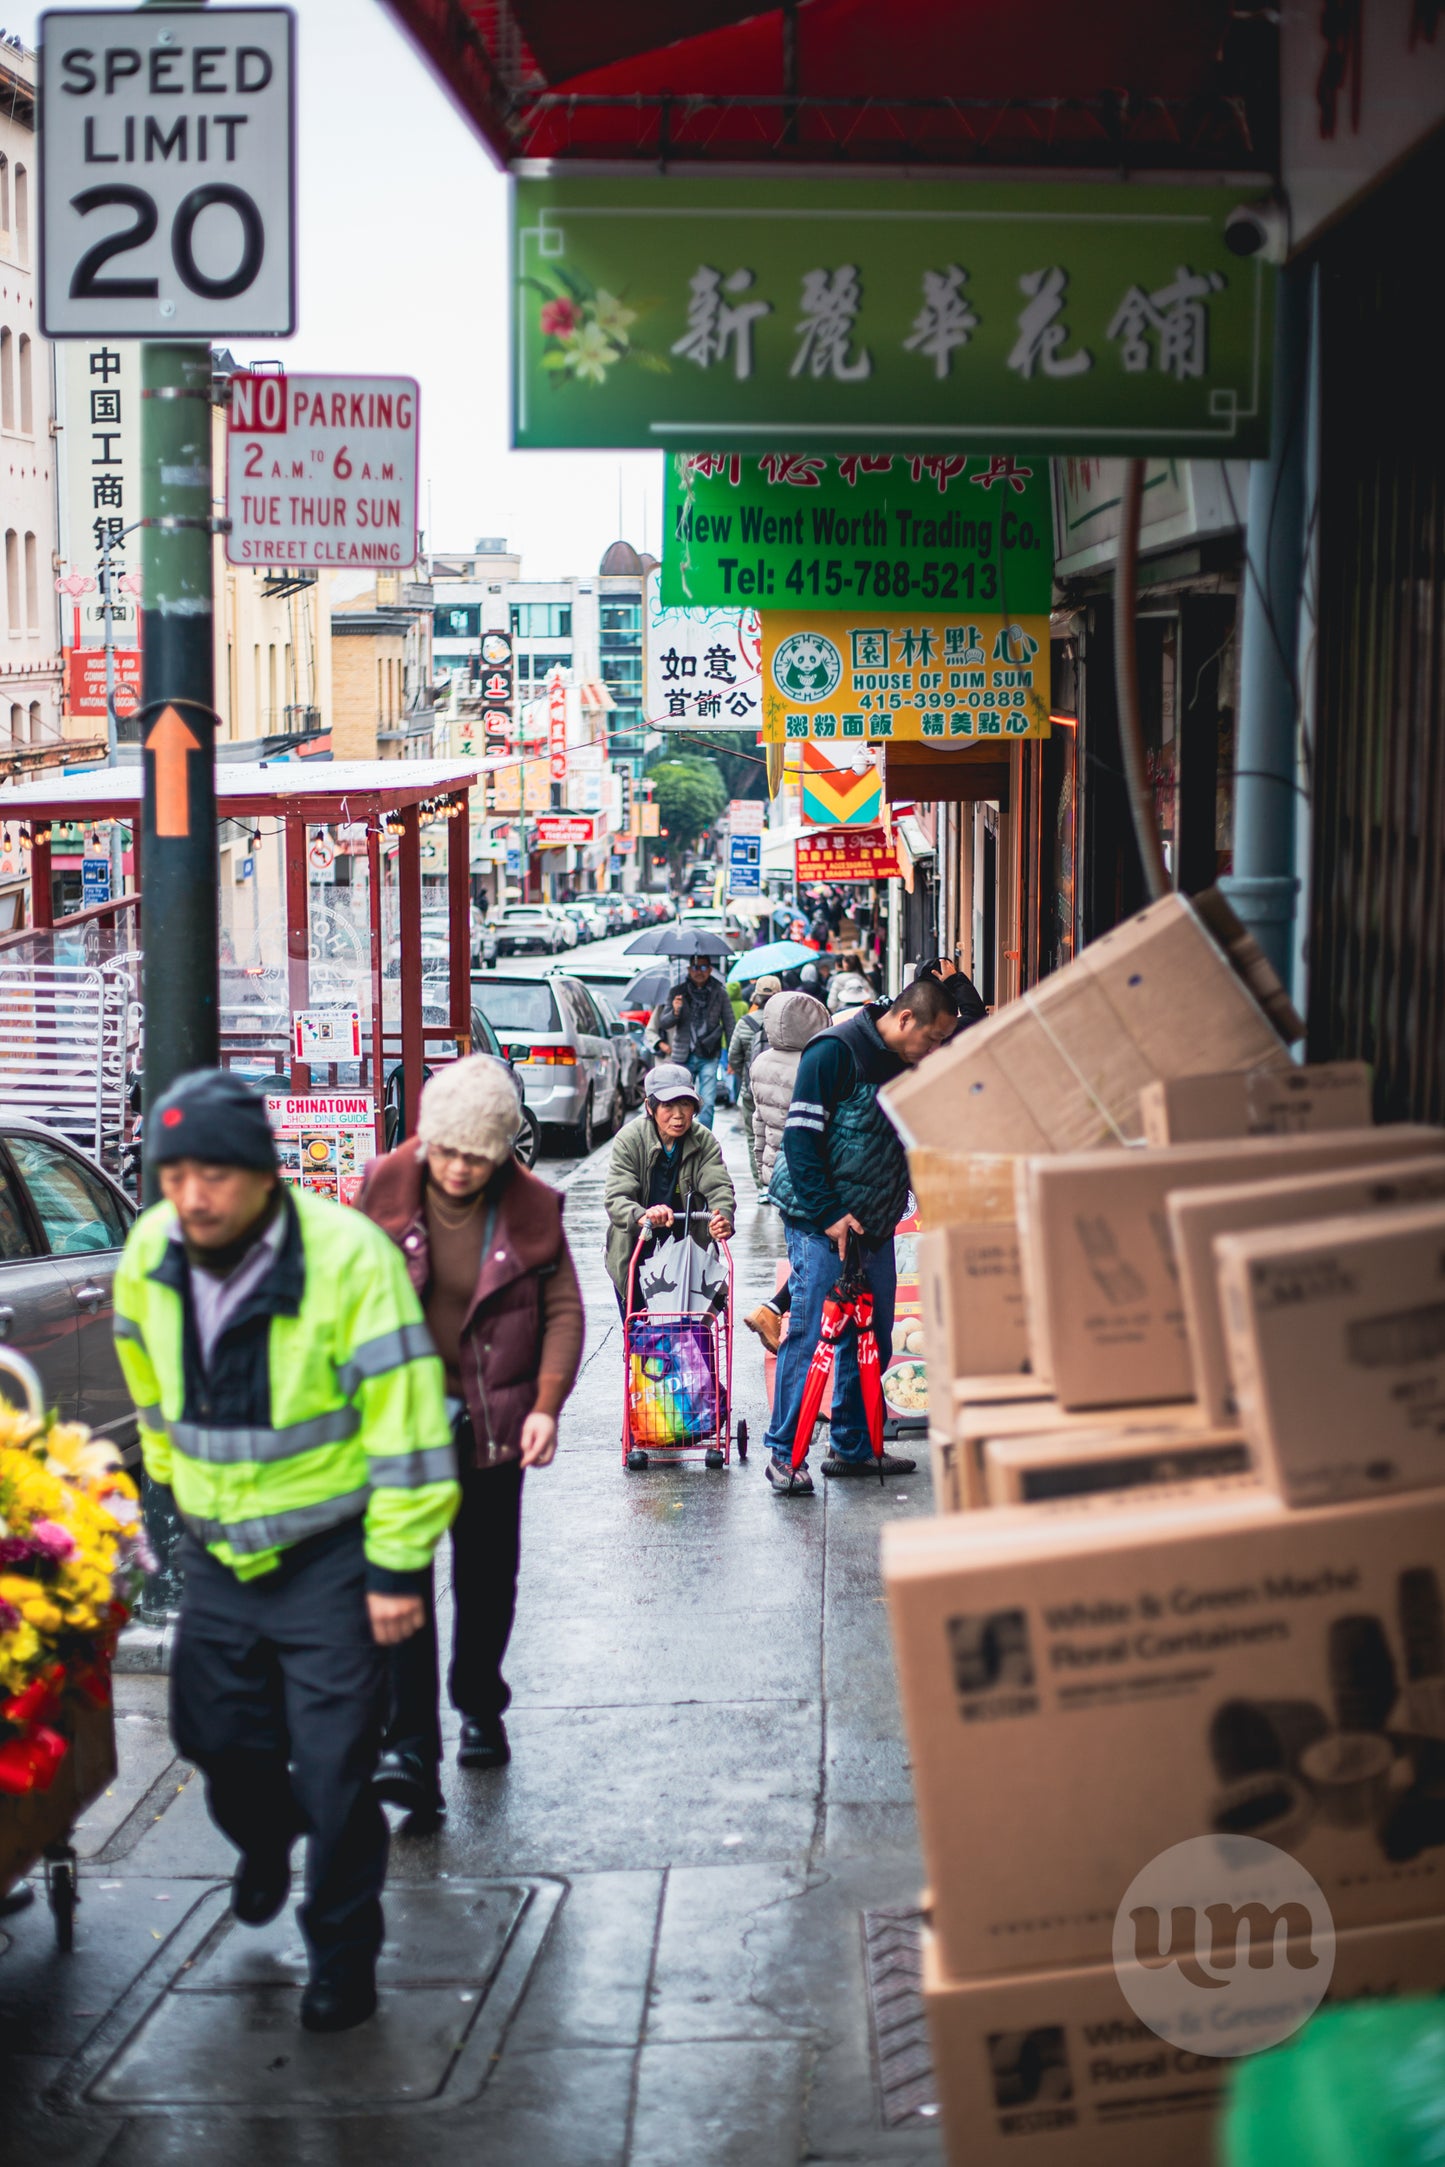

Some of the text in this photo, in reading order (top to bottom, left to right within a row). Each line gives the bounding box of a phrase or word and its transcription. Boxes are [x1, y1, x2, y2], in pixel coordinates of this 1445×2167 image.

[61, 46, 273, 96] SPEED
[84, 114, 248, 164] LIMIT
[68, 182, 265, 300] 20
[232, 378, 413, 430] NO PARKING
[88, 346, 128, 595] 中国工商银行
[243, 442, 404, 481] 2 A.M. TO 6 A.M.
[241, 495, 401, 528] TUE THUR SUN
[676, 505, 1041, 559] New Went Worth Trading Co.
[241, 540, 401, 562] STREET CLEANING
[718, 557, 998, 600] Tel: 415-788-5213
[659, 643, 737, 685] 如意
[852, 670, 1033, 690] HOUSE OF DIM SUM
[858, 691, 1027, 710] 415-399-0888
[921, 711, 1029, 736] 精美點心
[268, 1099, 368, 1114] SF CHINATOWN
[287, 1113, 368, 1124] SHOP DINE GUIDE
[630, 1370, 695, 1409] PRIDE
[1042, 1595, 1132, 1631] White
[1136, 1595, 1165, 1620] &
[1168, 1584, 1256, 1617] Green
[1049, 1617, 1291, 1670] Floral Containers
